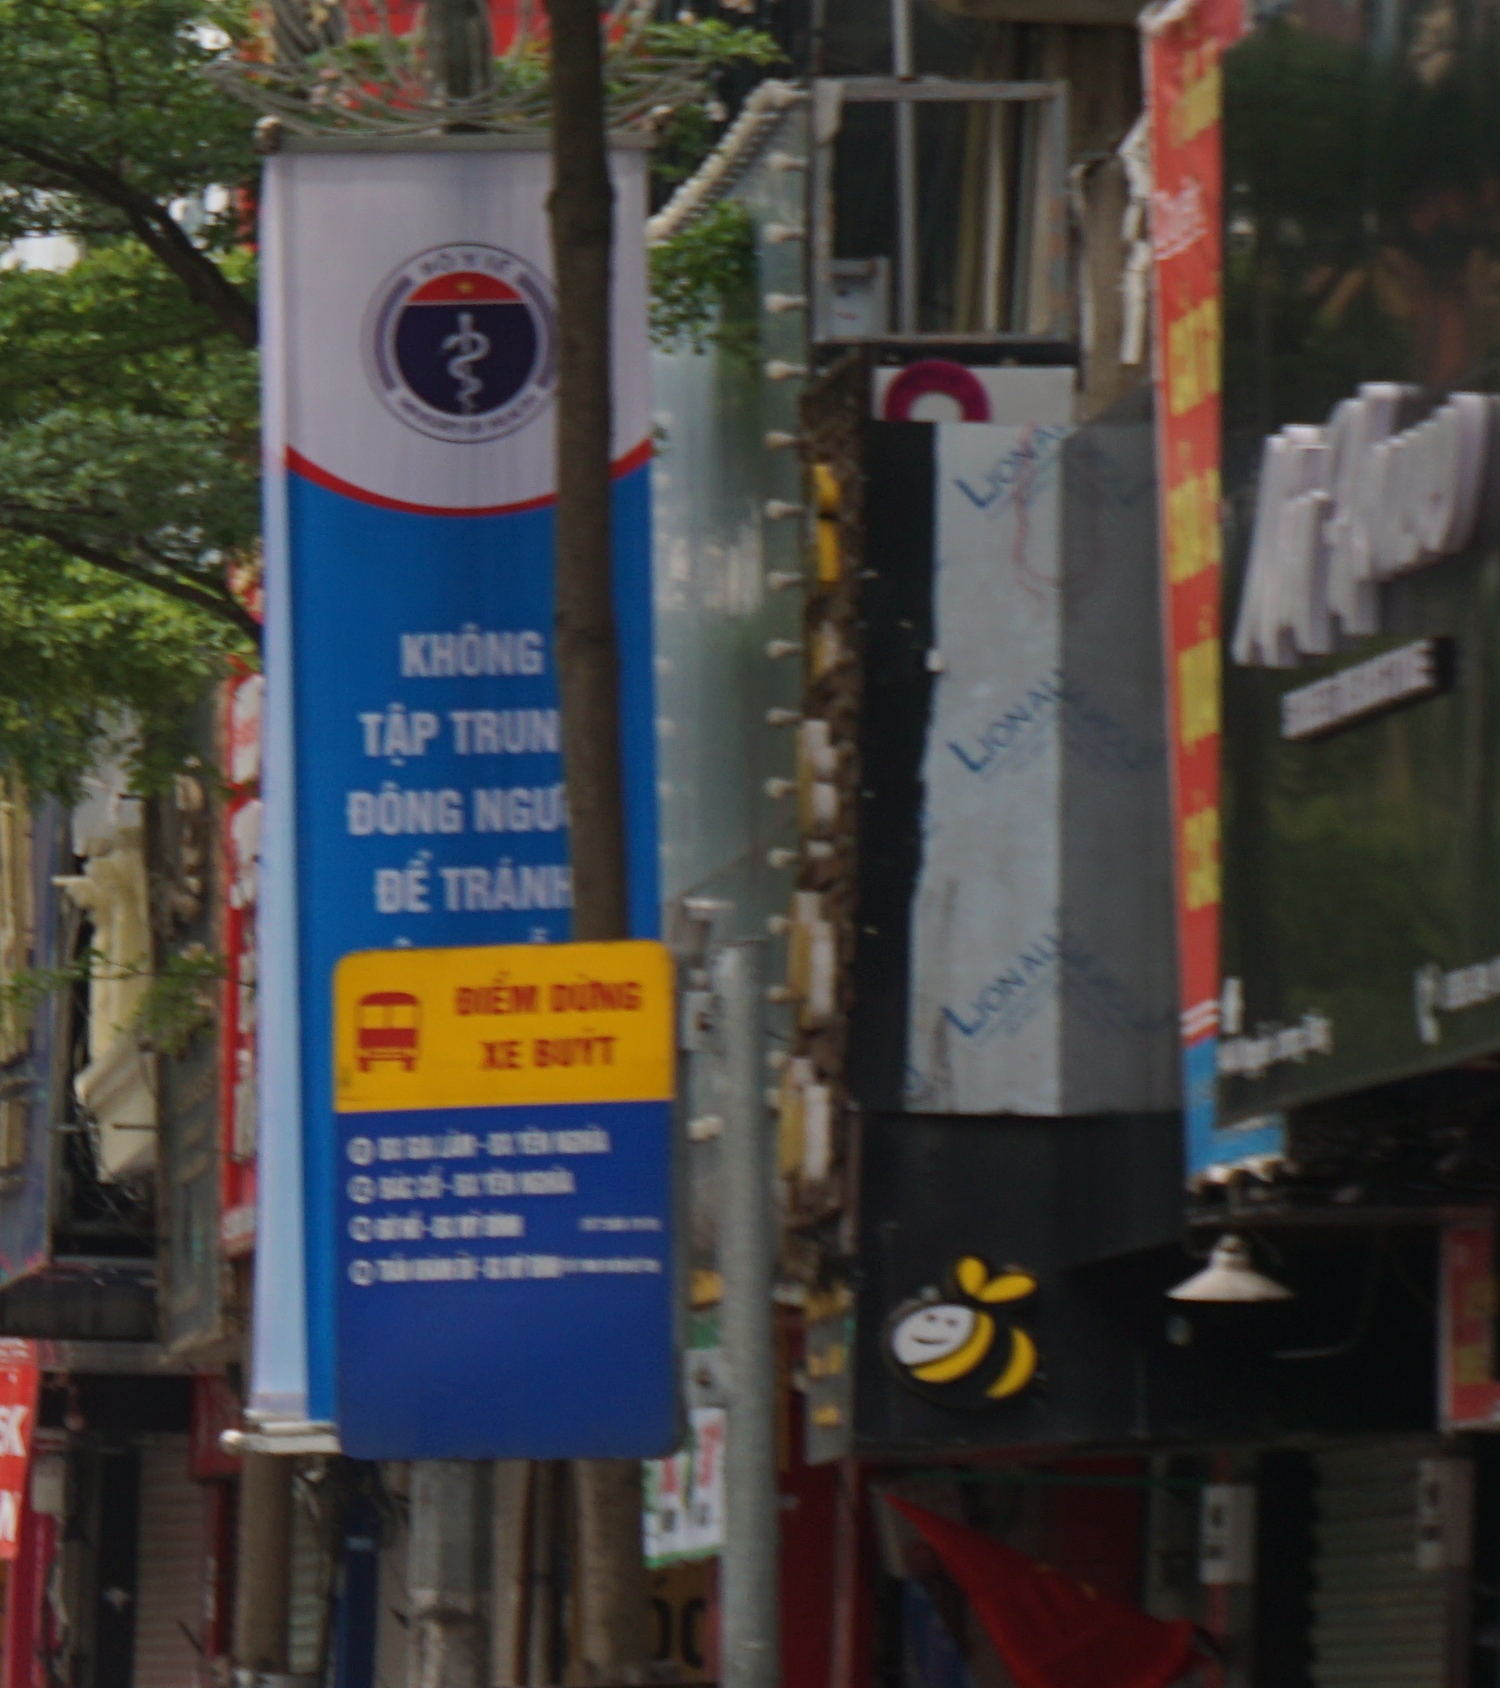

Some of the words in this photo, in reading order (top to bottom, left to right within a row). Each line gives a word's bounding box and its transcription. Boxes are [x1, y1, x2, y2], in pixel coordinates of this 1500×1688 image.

[401, 623, 545, 679] KHÔNG
[358, 702, 439, 766] TẬP
[449, 707, 561, 756] TRUN
[346, 780, 463, 837] ĐÔNG
[373, 850, 433, 915] ĐỂ
[479, 1039, 524, 1071] XE
